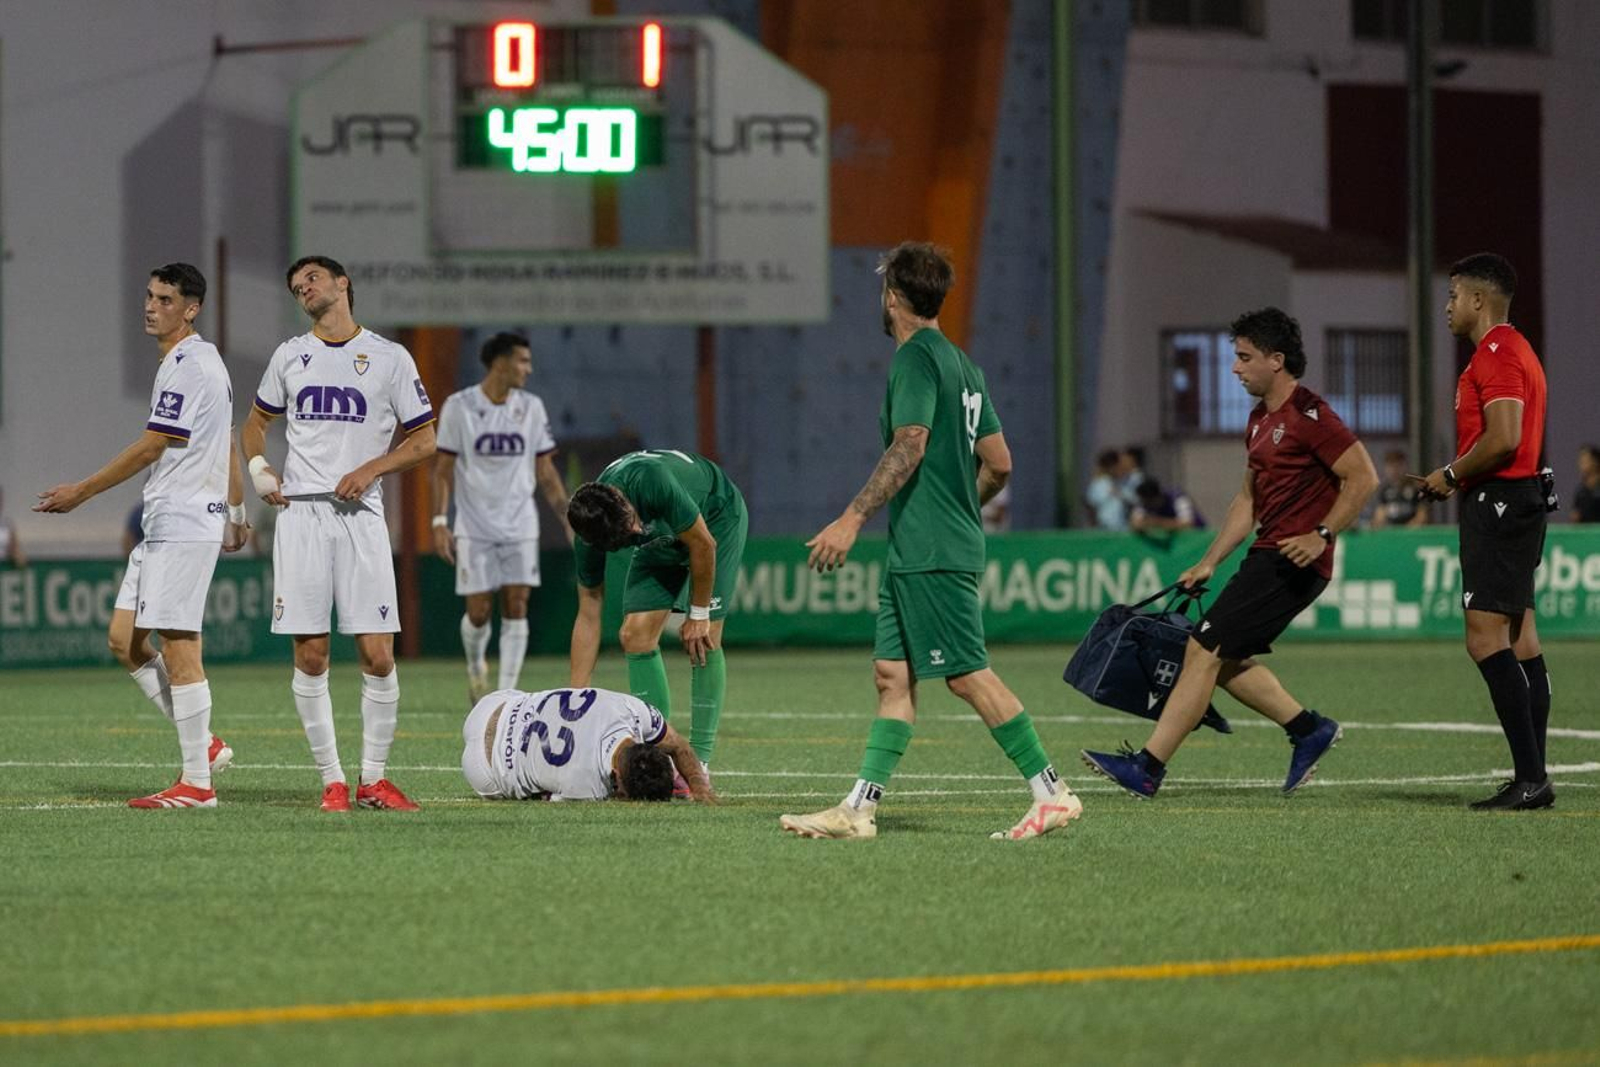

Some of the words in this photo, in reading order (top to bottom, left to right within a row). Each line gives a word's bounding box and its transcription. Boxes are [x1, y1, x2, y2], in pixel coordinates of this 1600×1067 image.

[494, 23, 535, 87] 0
[643, 23, 661, 87] 1
[207, 501, 229, 514] cal
[1, 567, 36, 626] El
[730, 561, 880, 612] MUEBL
[520, 689, 597, 767] 22
